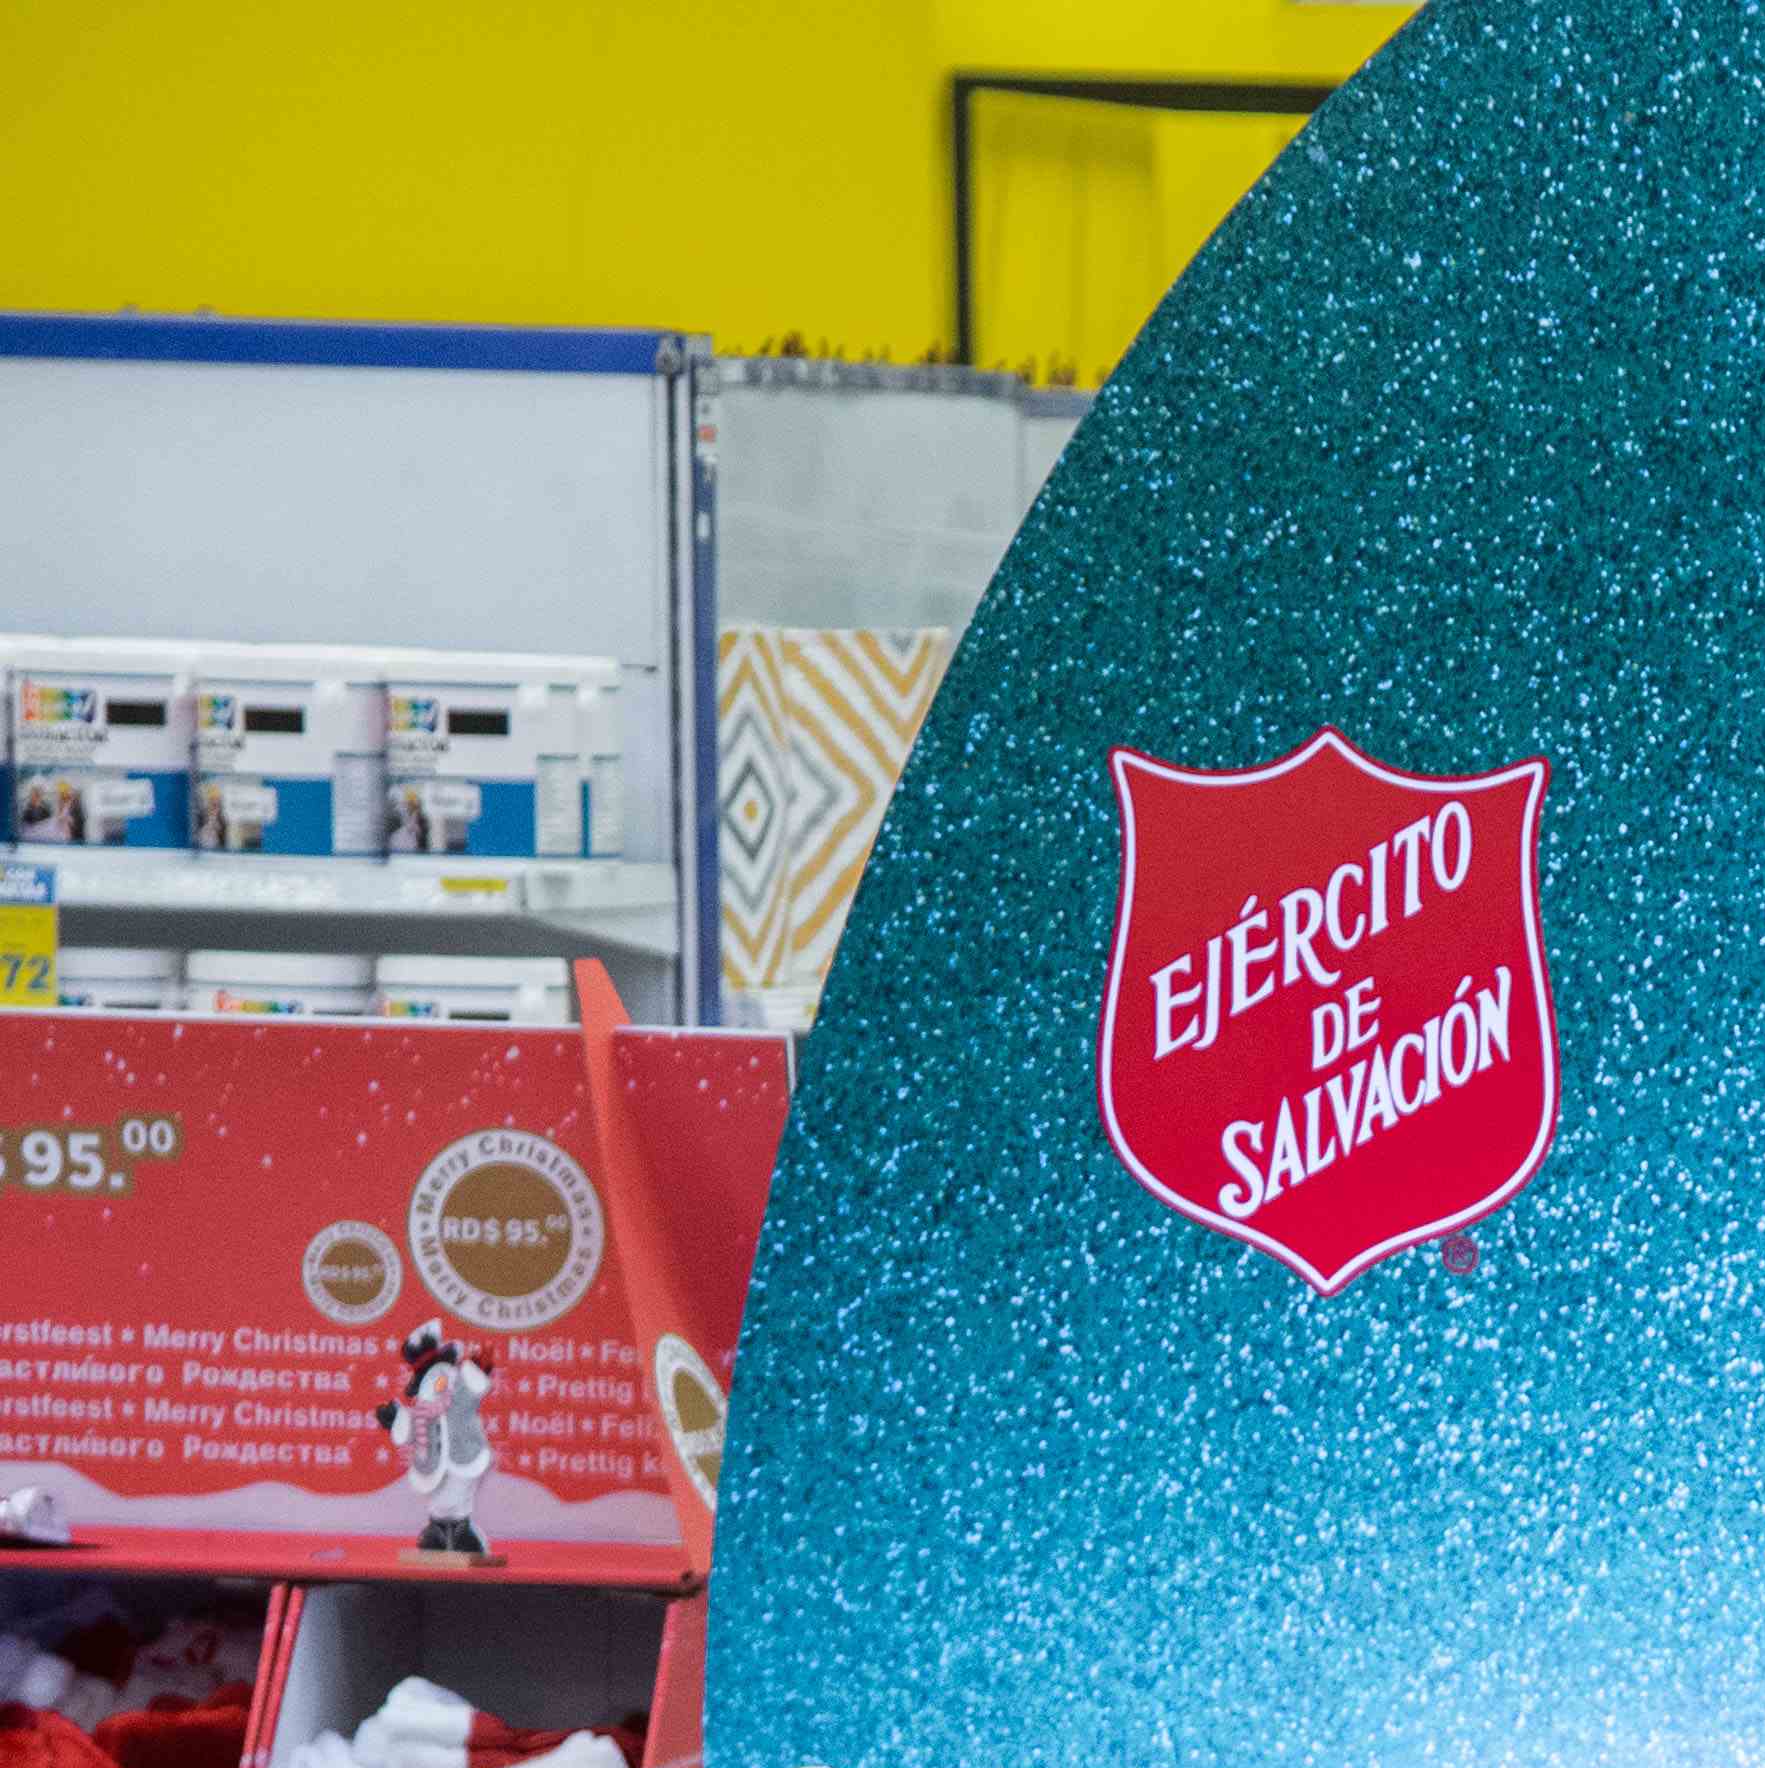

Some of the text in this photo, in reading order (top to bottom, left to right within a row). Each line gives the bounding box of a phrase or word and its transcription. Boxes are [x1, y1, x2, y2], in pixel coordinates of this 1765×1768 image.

[1149, 801, 1473, 1061] EJÉRCITO
[1218, 965, 1511, 1219] SALVACIÓN
[1311, 976, 1382, 1072] DE
[142, 1322, 225, 1355] Merry
[233, 1326, 379, 1356] Christmas
